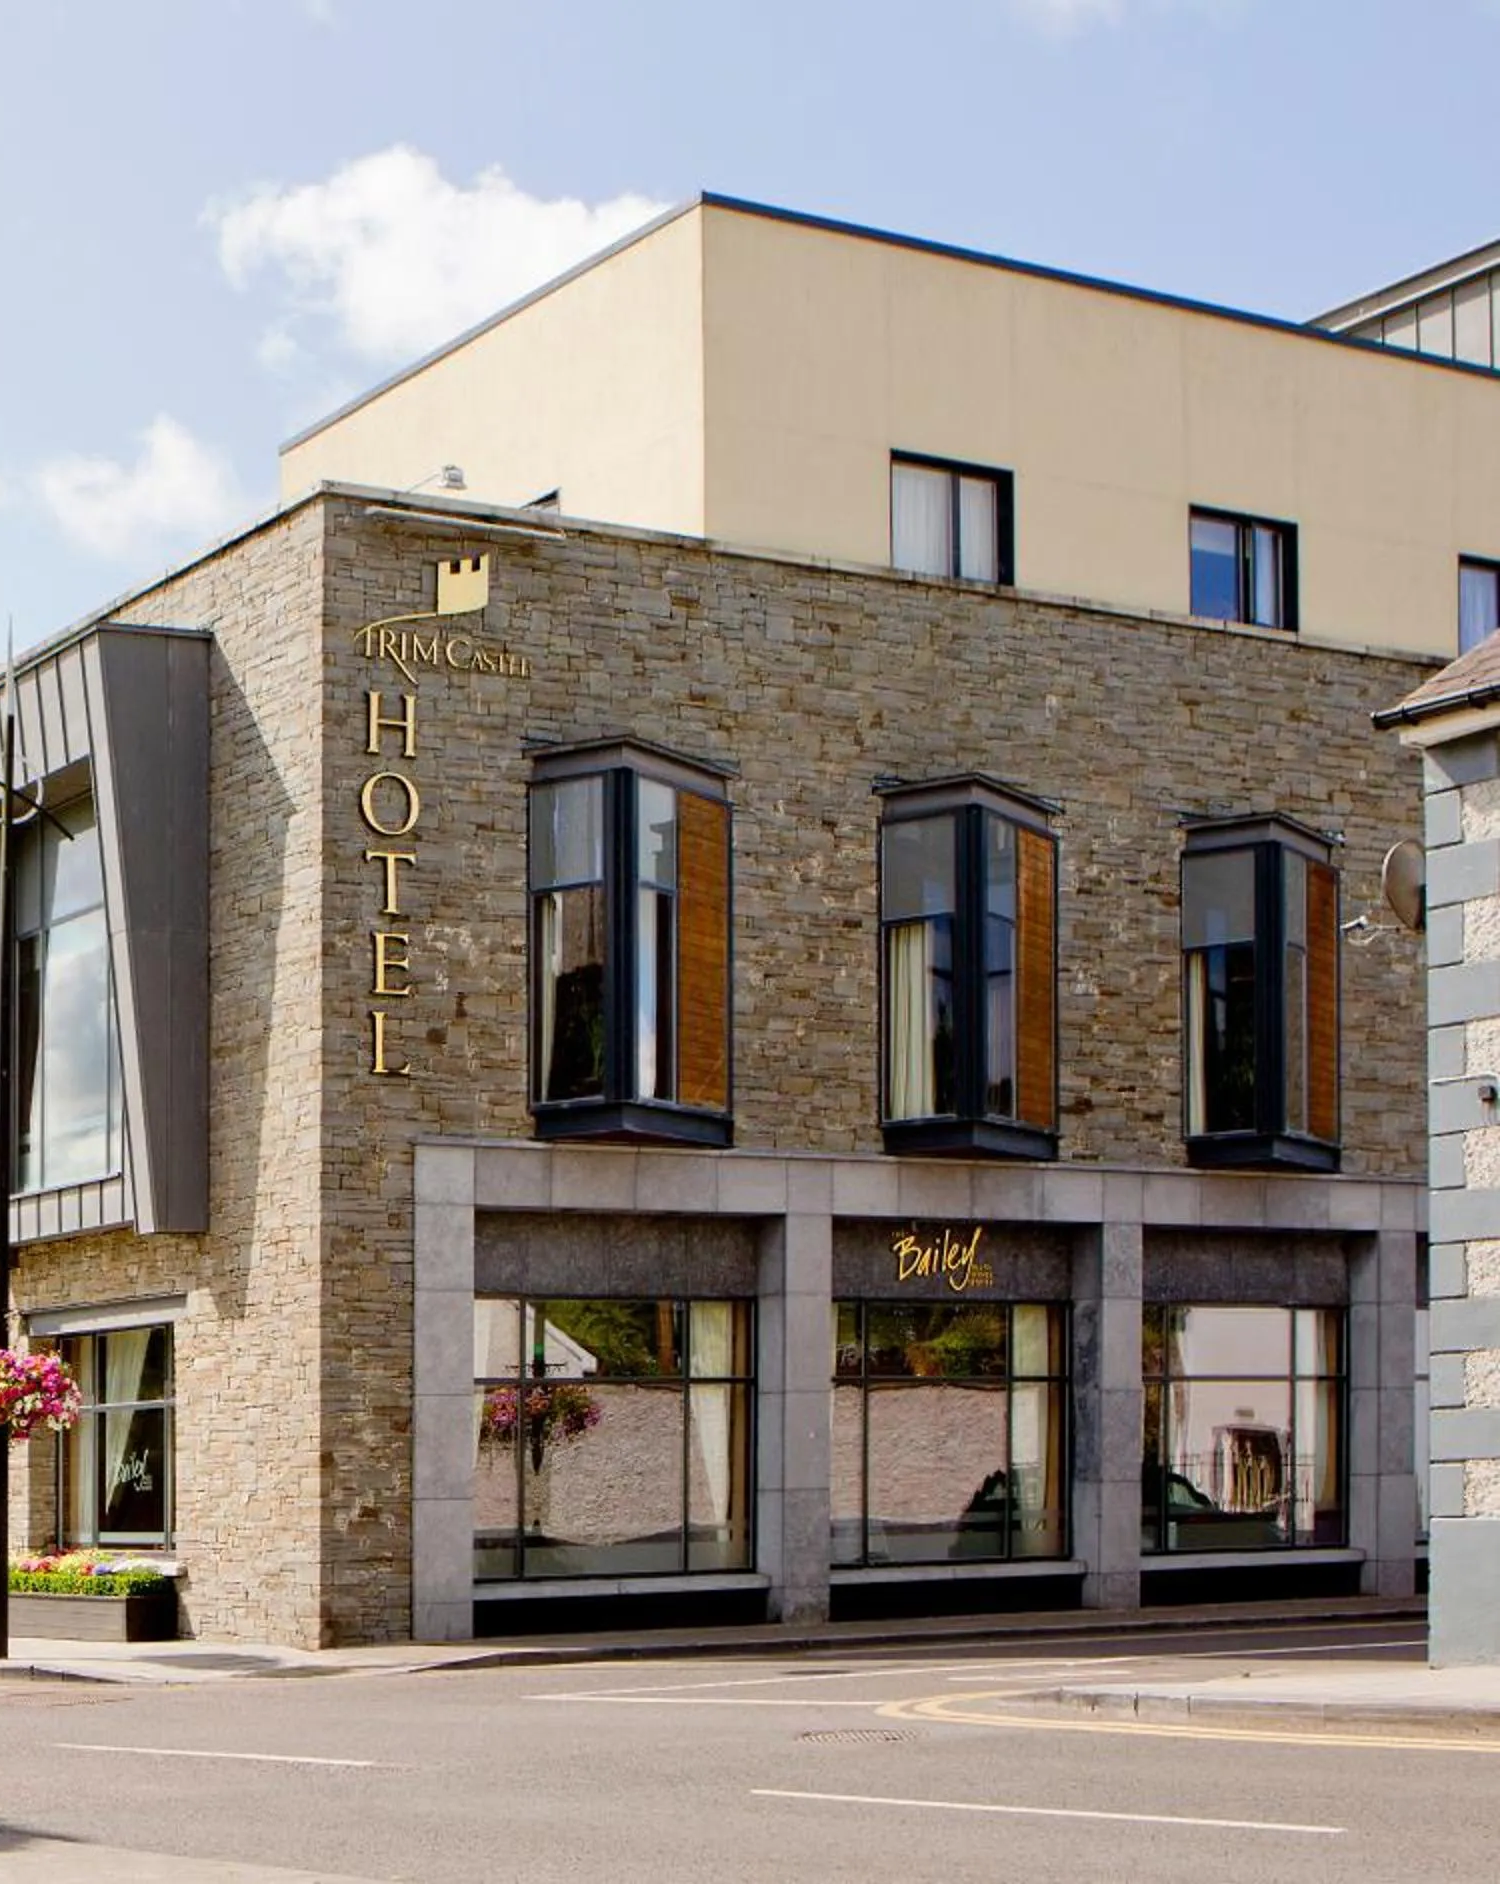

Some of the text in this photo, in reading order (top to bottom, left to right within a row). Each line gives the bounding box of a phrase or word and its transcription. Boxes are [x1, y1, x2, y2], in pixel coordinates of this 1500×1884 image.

[355, 622, 533, 685] TRIM CASTLE
[361, 690, 419, 1075] HOTEL
[893, 1227, 982, 1291] Bailey
